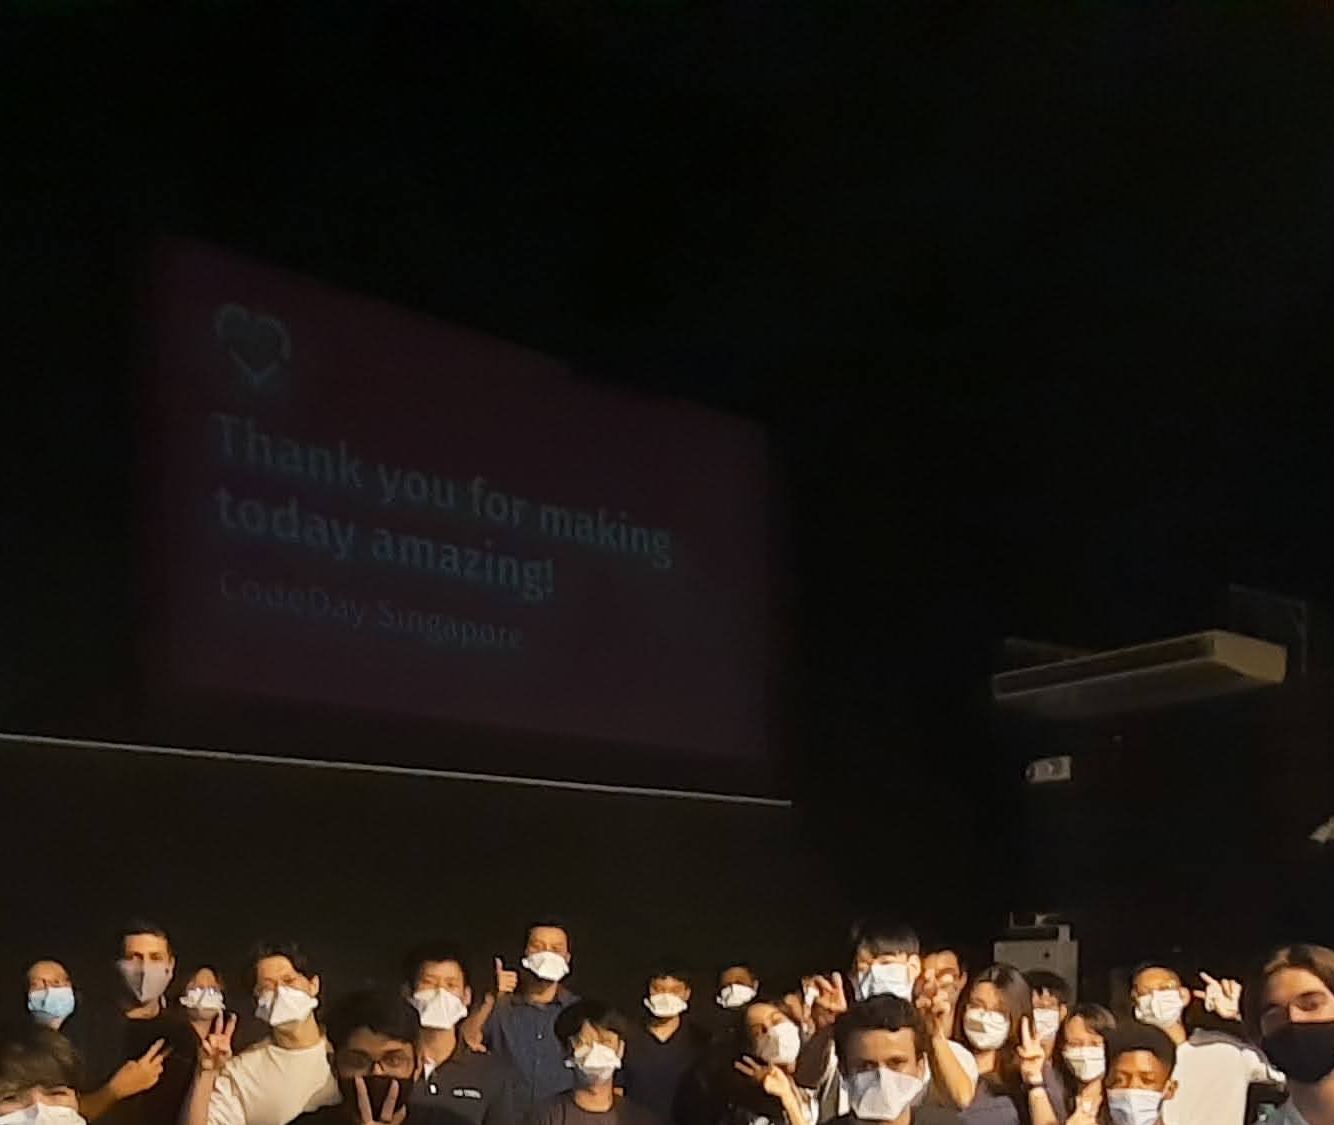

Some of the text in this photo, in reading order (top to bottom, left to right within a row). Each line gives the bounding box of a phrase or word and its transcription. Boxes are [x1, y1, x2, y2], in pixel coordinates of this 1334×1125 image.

[211, 411, 674, 570] Thank you for making
[212, 486, 556, 601] today amazing!
[218, 569, 524, 649] CodeDay Singapore
